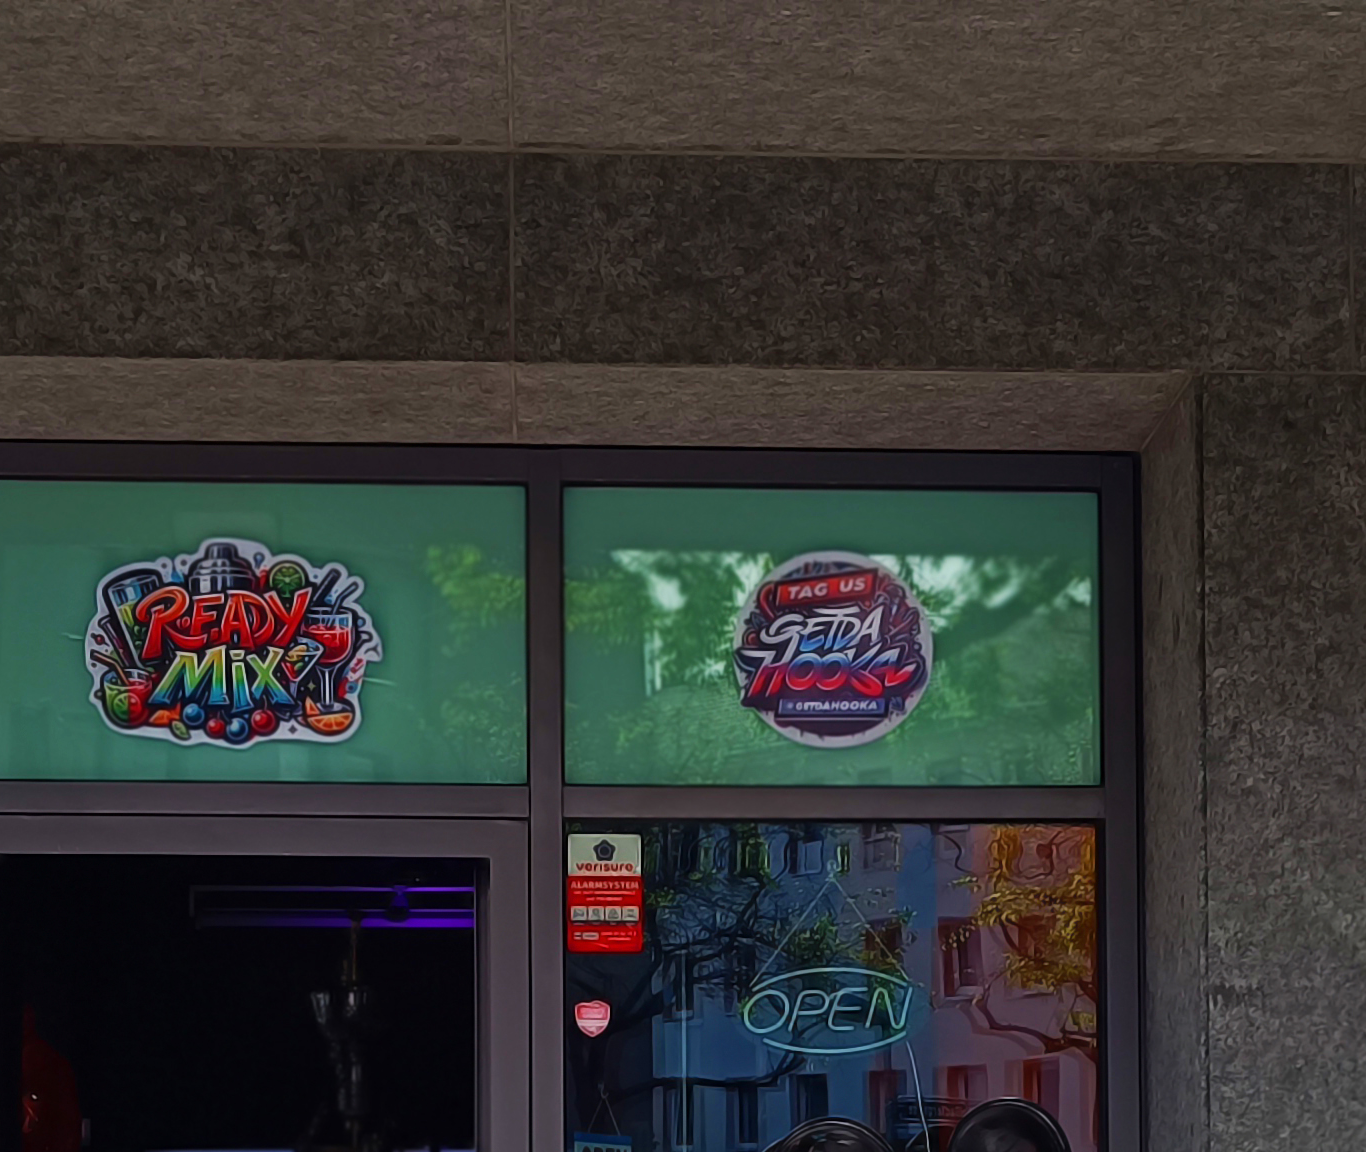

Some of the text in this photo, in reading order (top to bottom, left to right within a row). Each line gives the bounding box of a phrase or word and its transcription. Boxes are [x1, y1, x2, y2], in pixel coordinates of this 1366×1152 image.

[788, 577, 866, 600] TAG US
[135, 585, 313, 660] READY
[759, 606, 885, 656] GETDA
[571, 880, 639, 889] ALARMSYSTEM
[576, 863, 633, 872] verisure
[743, 986, 913, 1034] OPEN
